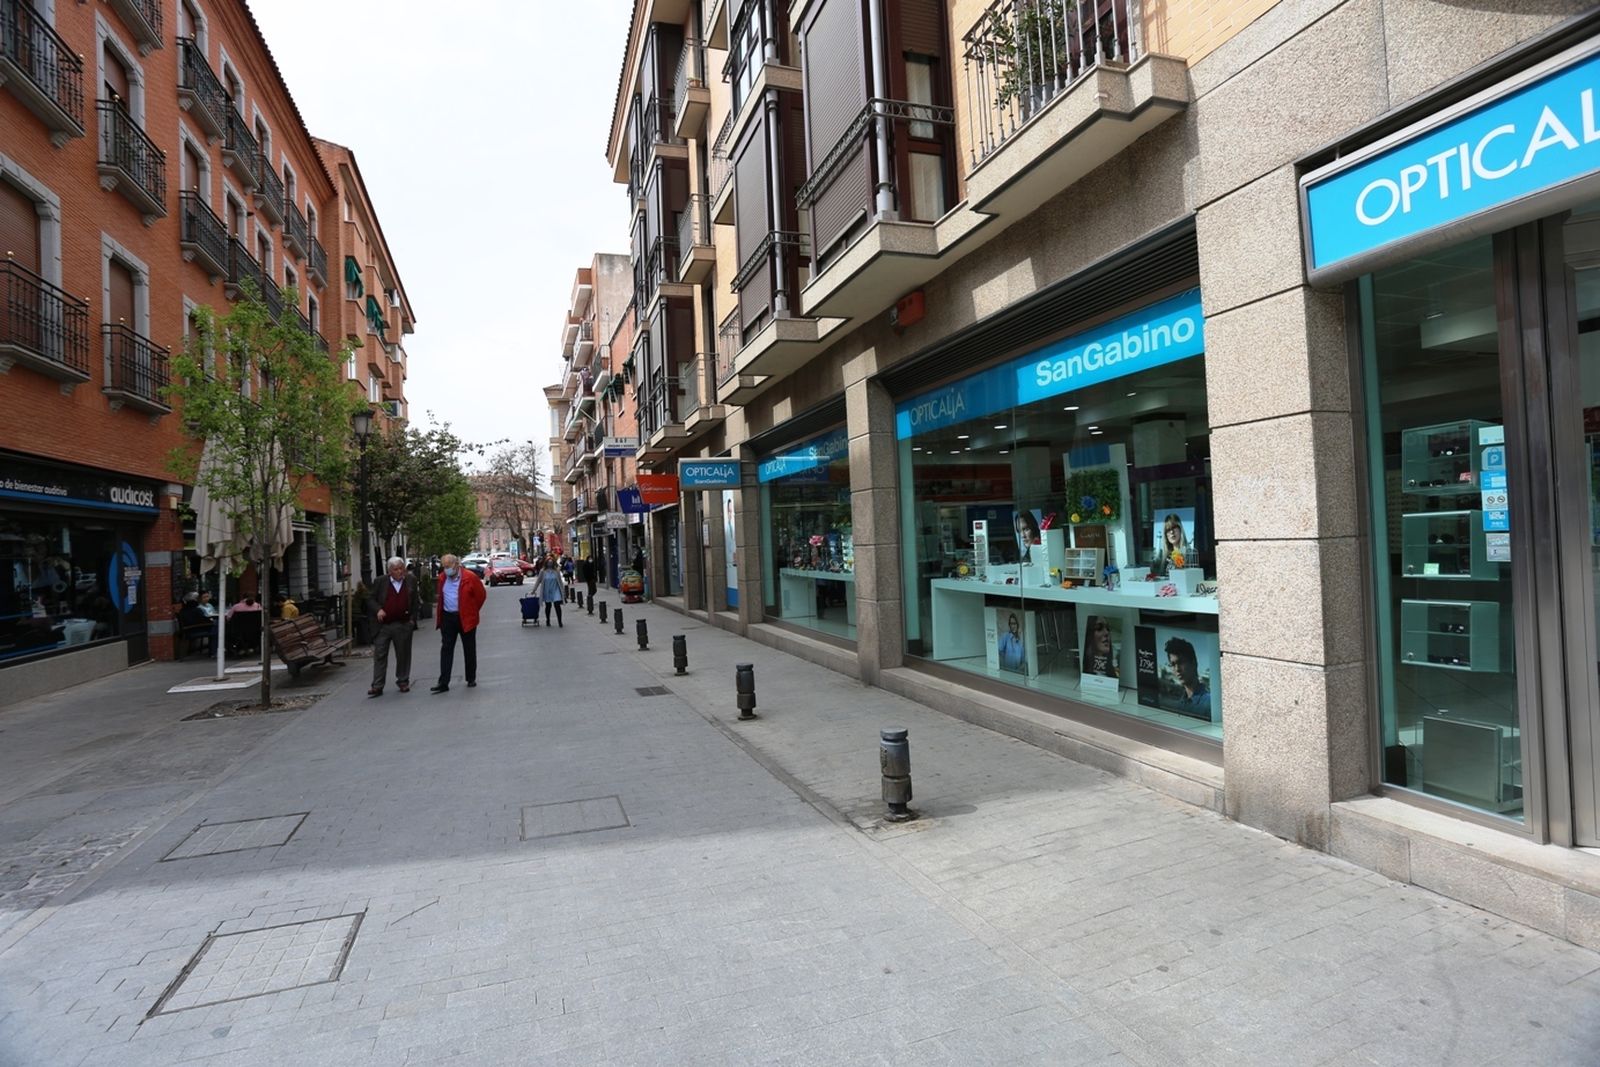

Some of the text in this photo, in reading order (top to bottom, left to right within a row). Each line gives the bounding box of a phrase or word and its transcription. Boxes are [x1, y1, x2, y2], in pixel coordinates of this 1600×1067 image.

[1036, 317, 1195, 387] SanGabino
[808, 436, 847, 461] SanGabin
[14, 479, 44, 493] bienestar
[110, 485, 154, 507] audicost
